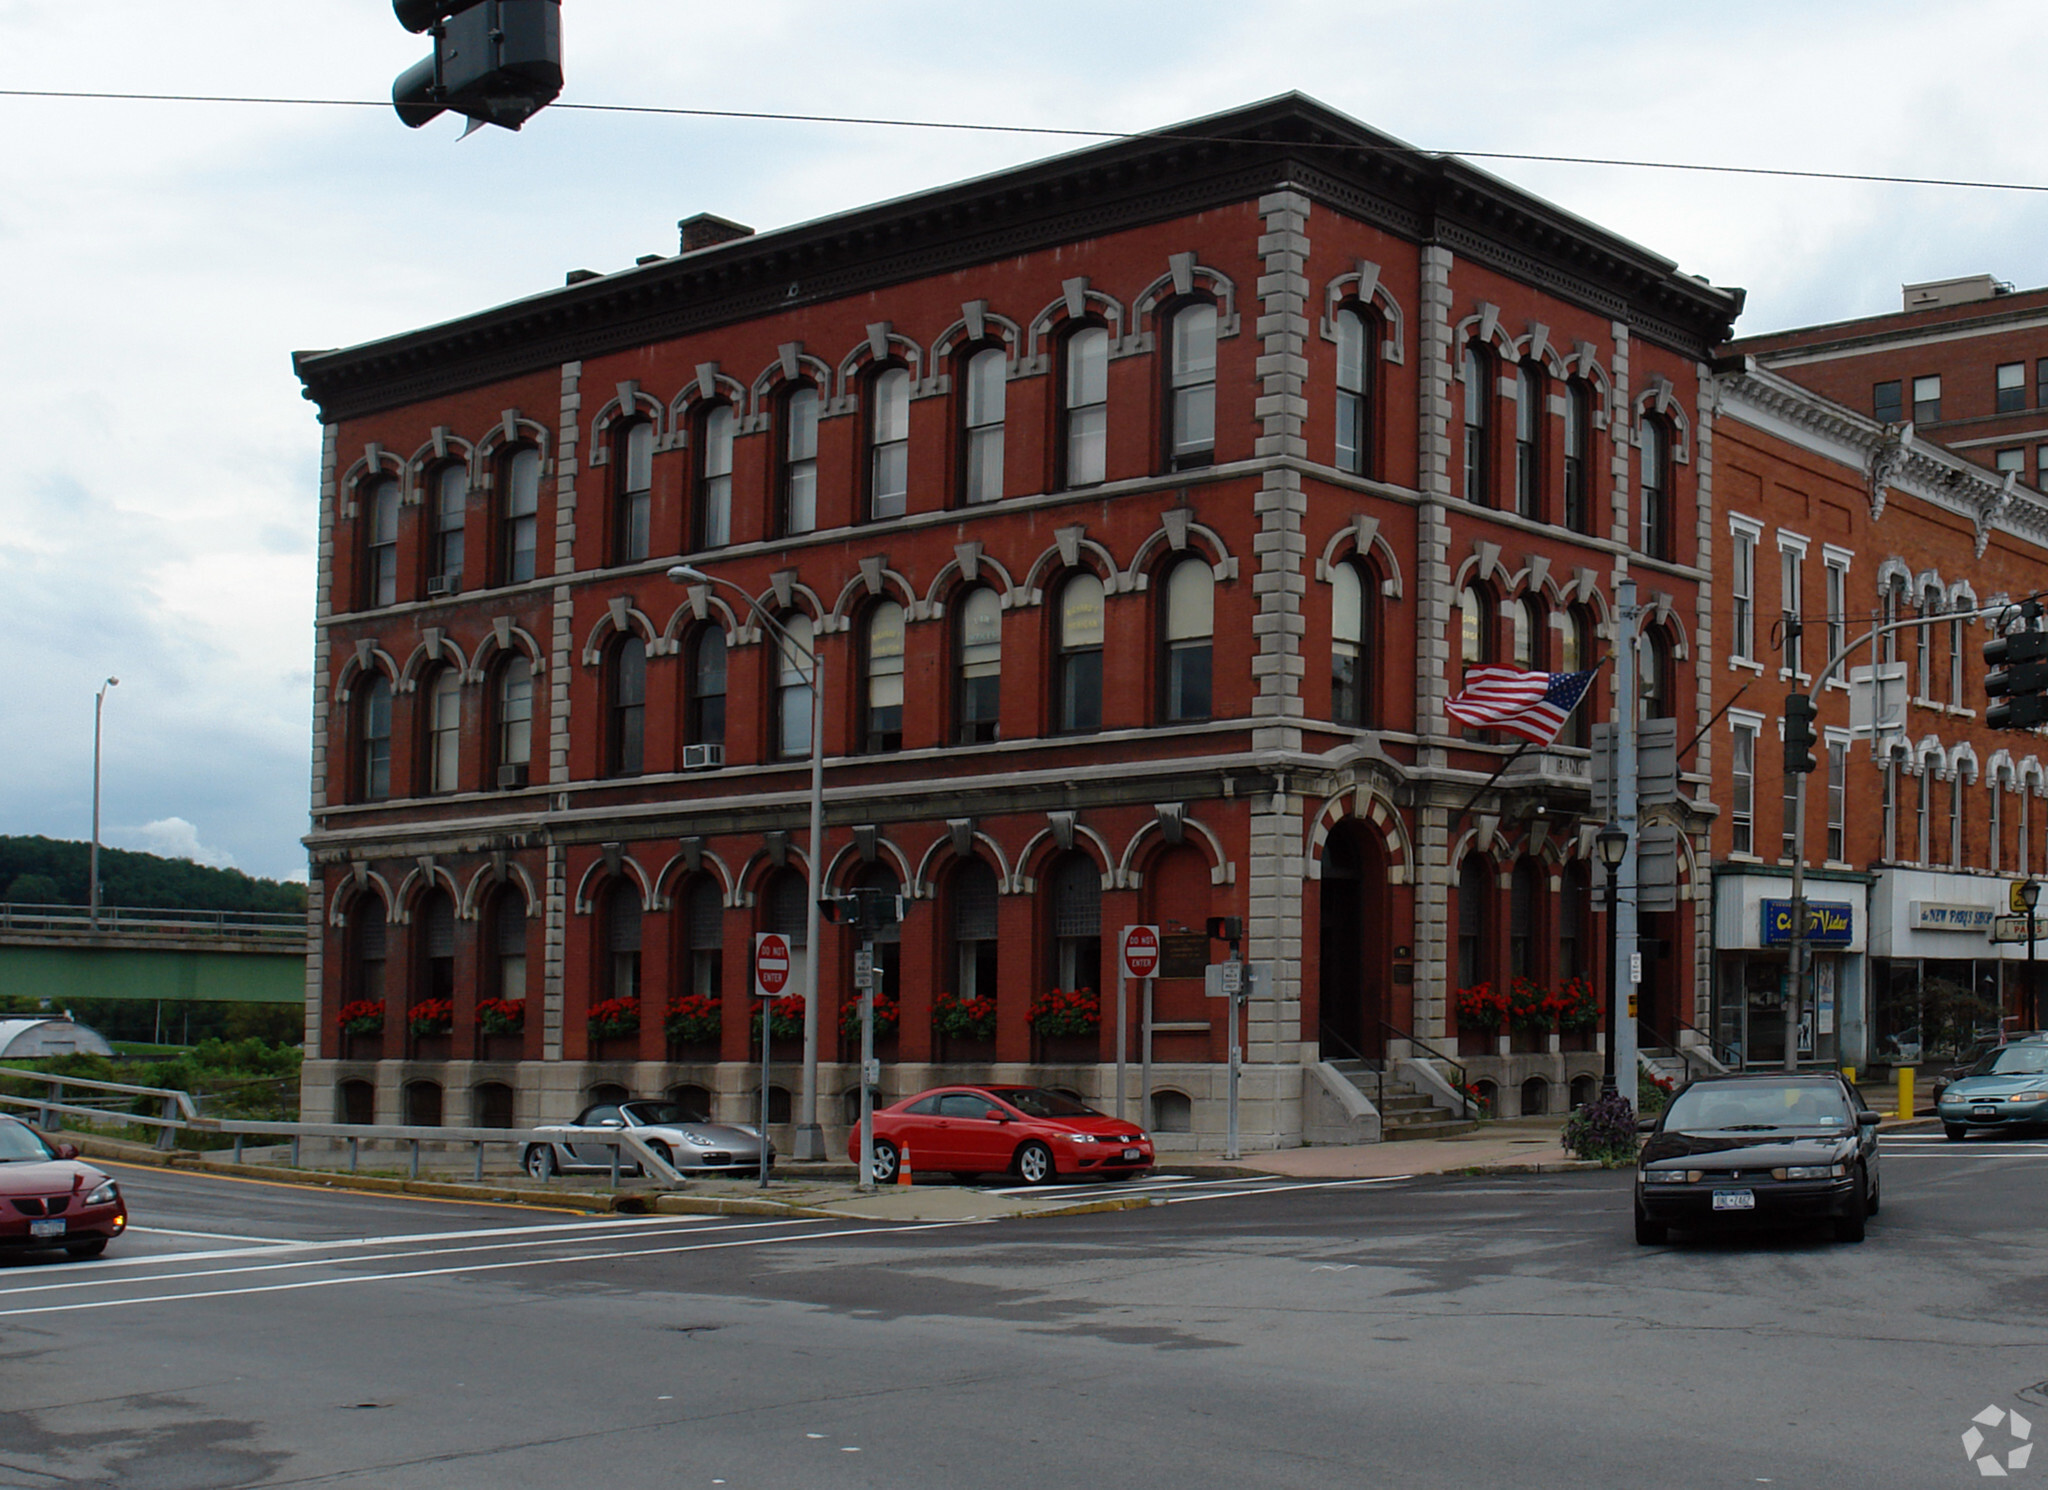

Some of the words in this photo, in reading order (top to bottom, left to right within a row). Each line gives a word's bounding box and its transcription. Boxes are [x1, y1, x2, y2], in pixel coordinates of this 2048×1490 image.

[1129, 936, 1139, 945] DO
[1141, 936, 1154, 945] NOT
[761, 945, 770, 956] DO
[773, 946, 785, 956] NOT
[1132, 959, 1152, 967] ENTER
[763, 972, 782, 983] ENTER
